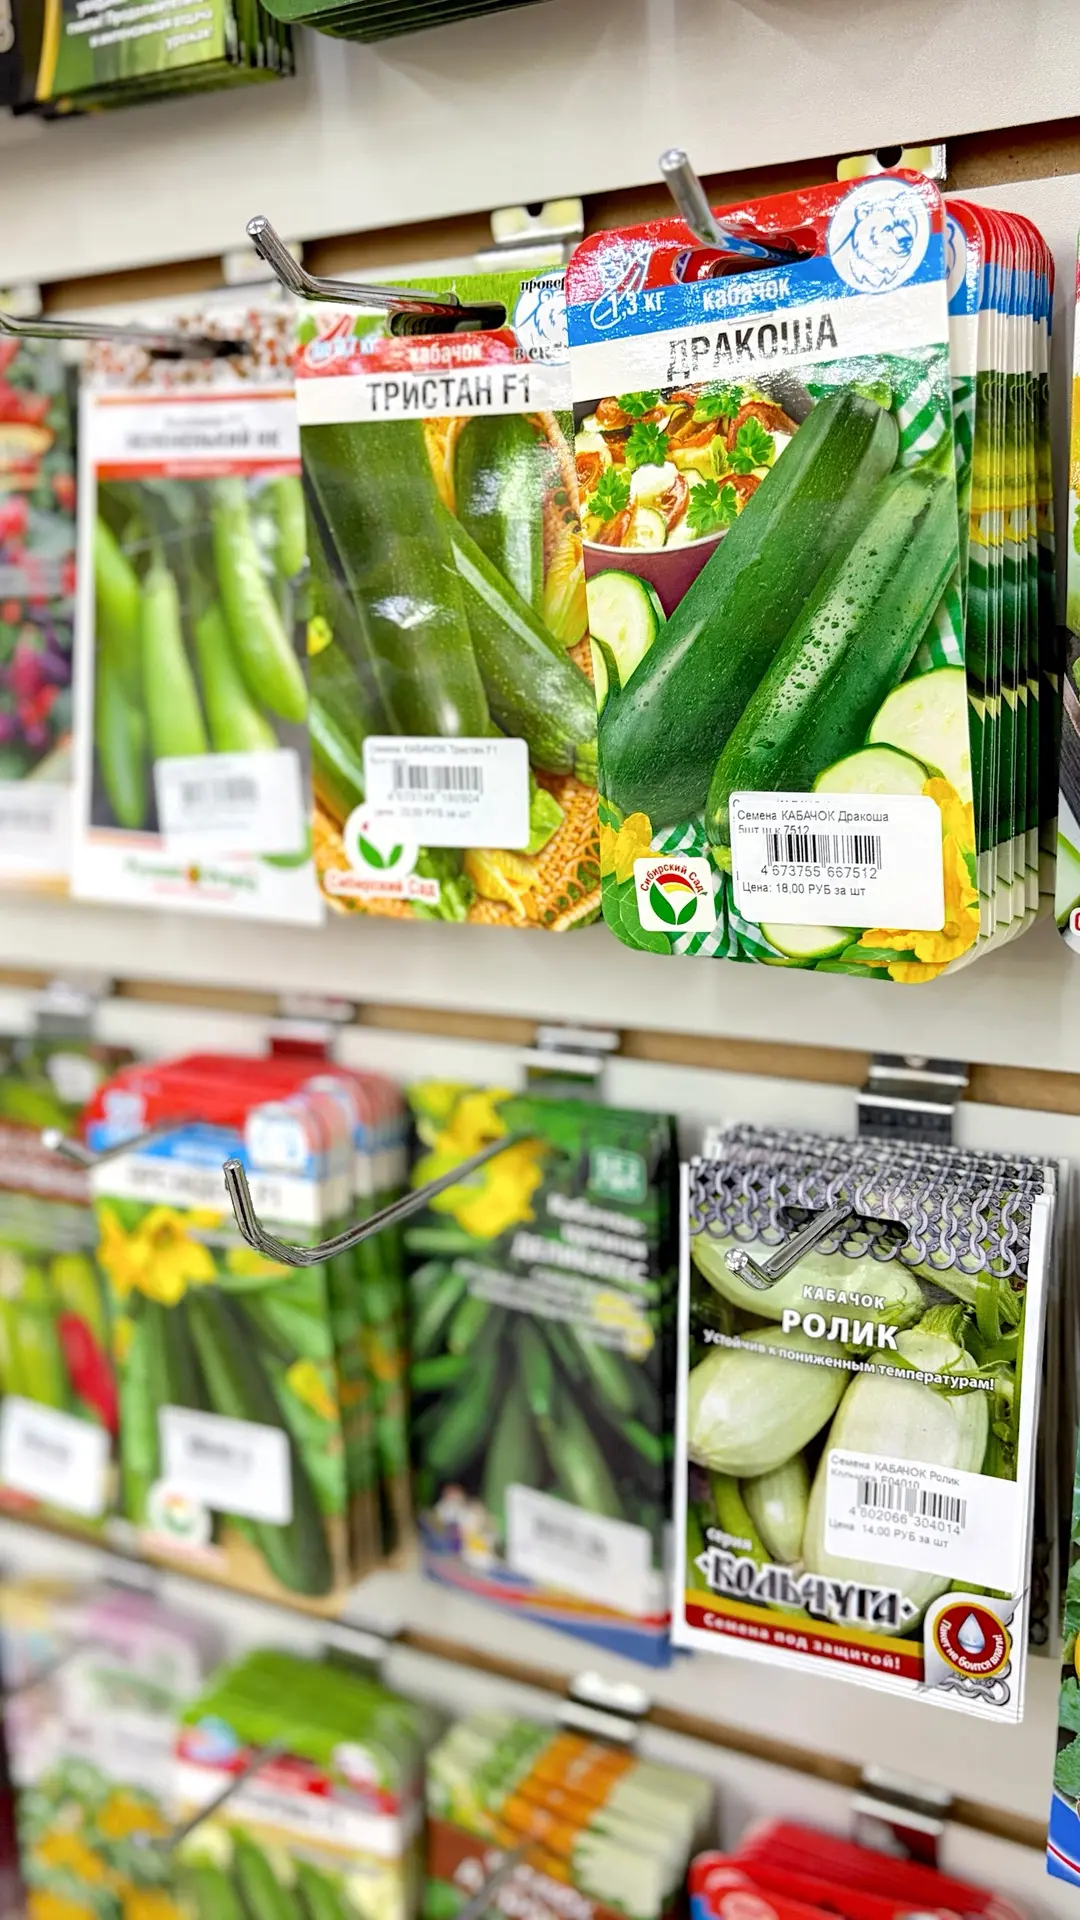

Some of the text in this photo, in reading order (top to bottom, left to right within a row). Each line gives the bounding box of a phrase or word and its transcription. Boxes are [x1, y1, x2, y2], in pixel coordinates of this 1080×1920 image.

[643, 291, 665, 312] кг
[702, 277, 791, 312] кабачок
[409, 342, 484, 365] кабачок
[667, 312, 839, 383] ДРАКОША
[366, 373, 531, 412] ТРИСТАН F1
[737, 809, 889, 823] Семена КАБАЧОК Дракоша
[784, 825, 810, 835] 7512
[640, 864, 704, 894] Сибирский Сад
[760, 865, 878, 880] 4 673755 667512
[742, 881, 773, 894] Цена:
[808, 884, 831, 895] РУБ
[835, 887, 846, 896] за
[850, 887, 866, 896] шт
[802, 1284, 885, 1310] КАБАЧОК
[781, 1309, 899, 1350] РОЛИК
[702, 1328, 766, 1354] Устойчив
[779, 1348, 876, 1374] пониженным
[878, 1363, 995, 1391] температурам!
[830, 1454, 960, 1487] Семена КАБАЧОК Ролик
[914, 1515, 961, 1536] 304014
[706, 1527, 752, 1551] серия
[893, 1528, 916, 1542] РУБ
[918, 1535, 930, 1544] за
[933, 1537, 949, 1549] шт
[703, 1611, 902, 1672] Семена под защитой!
